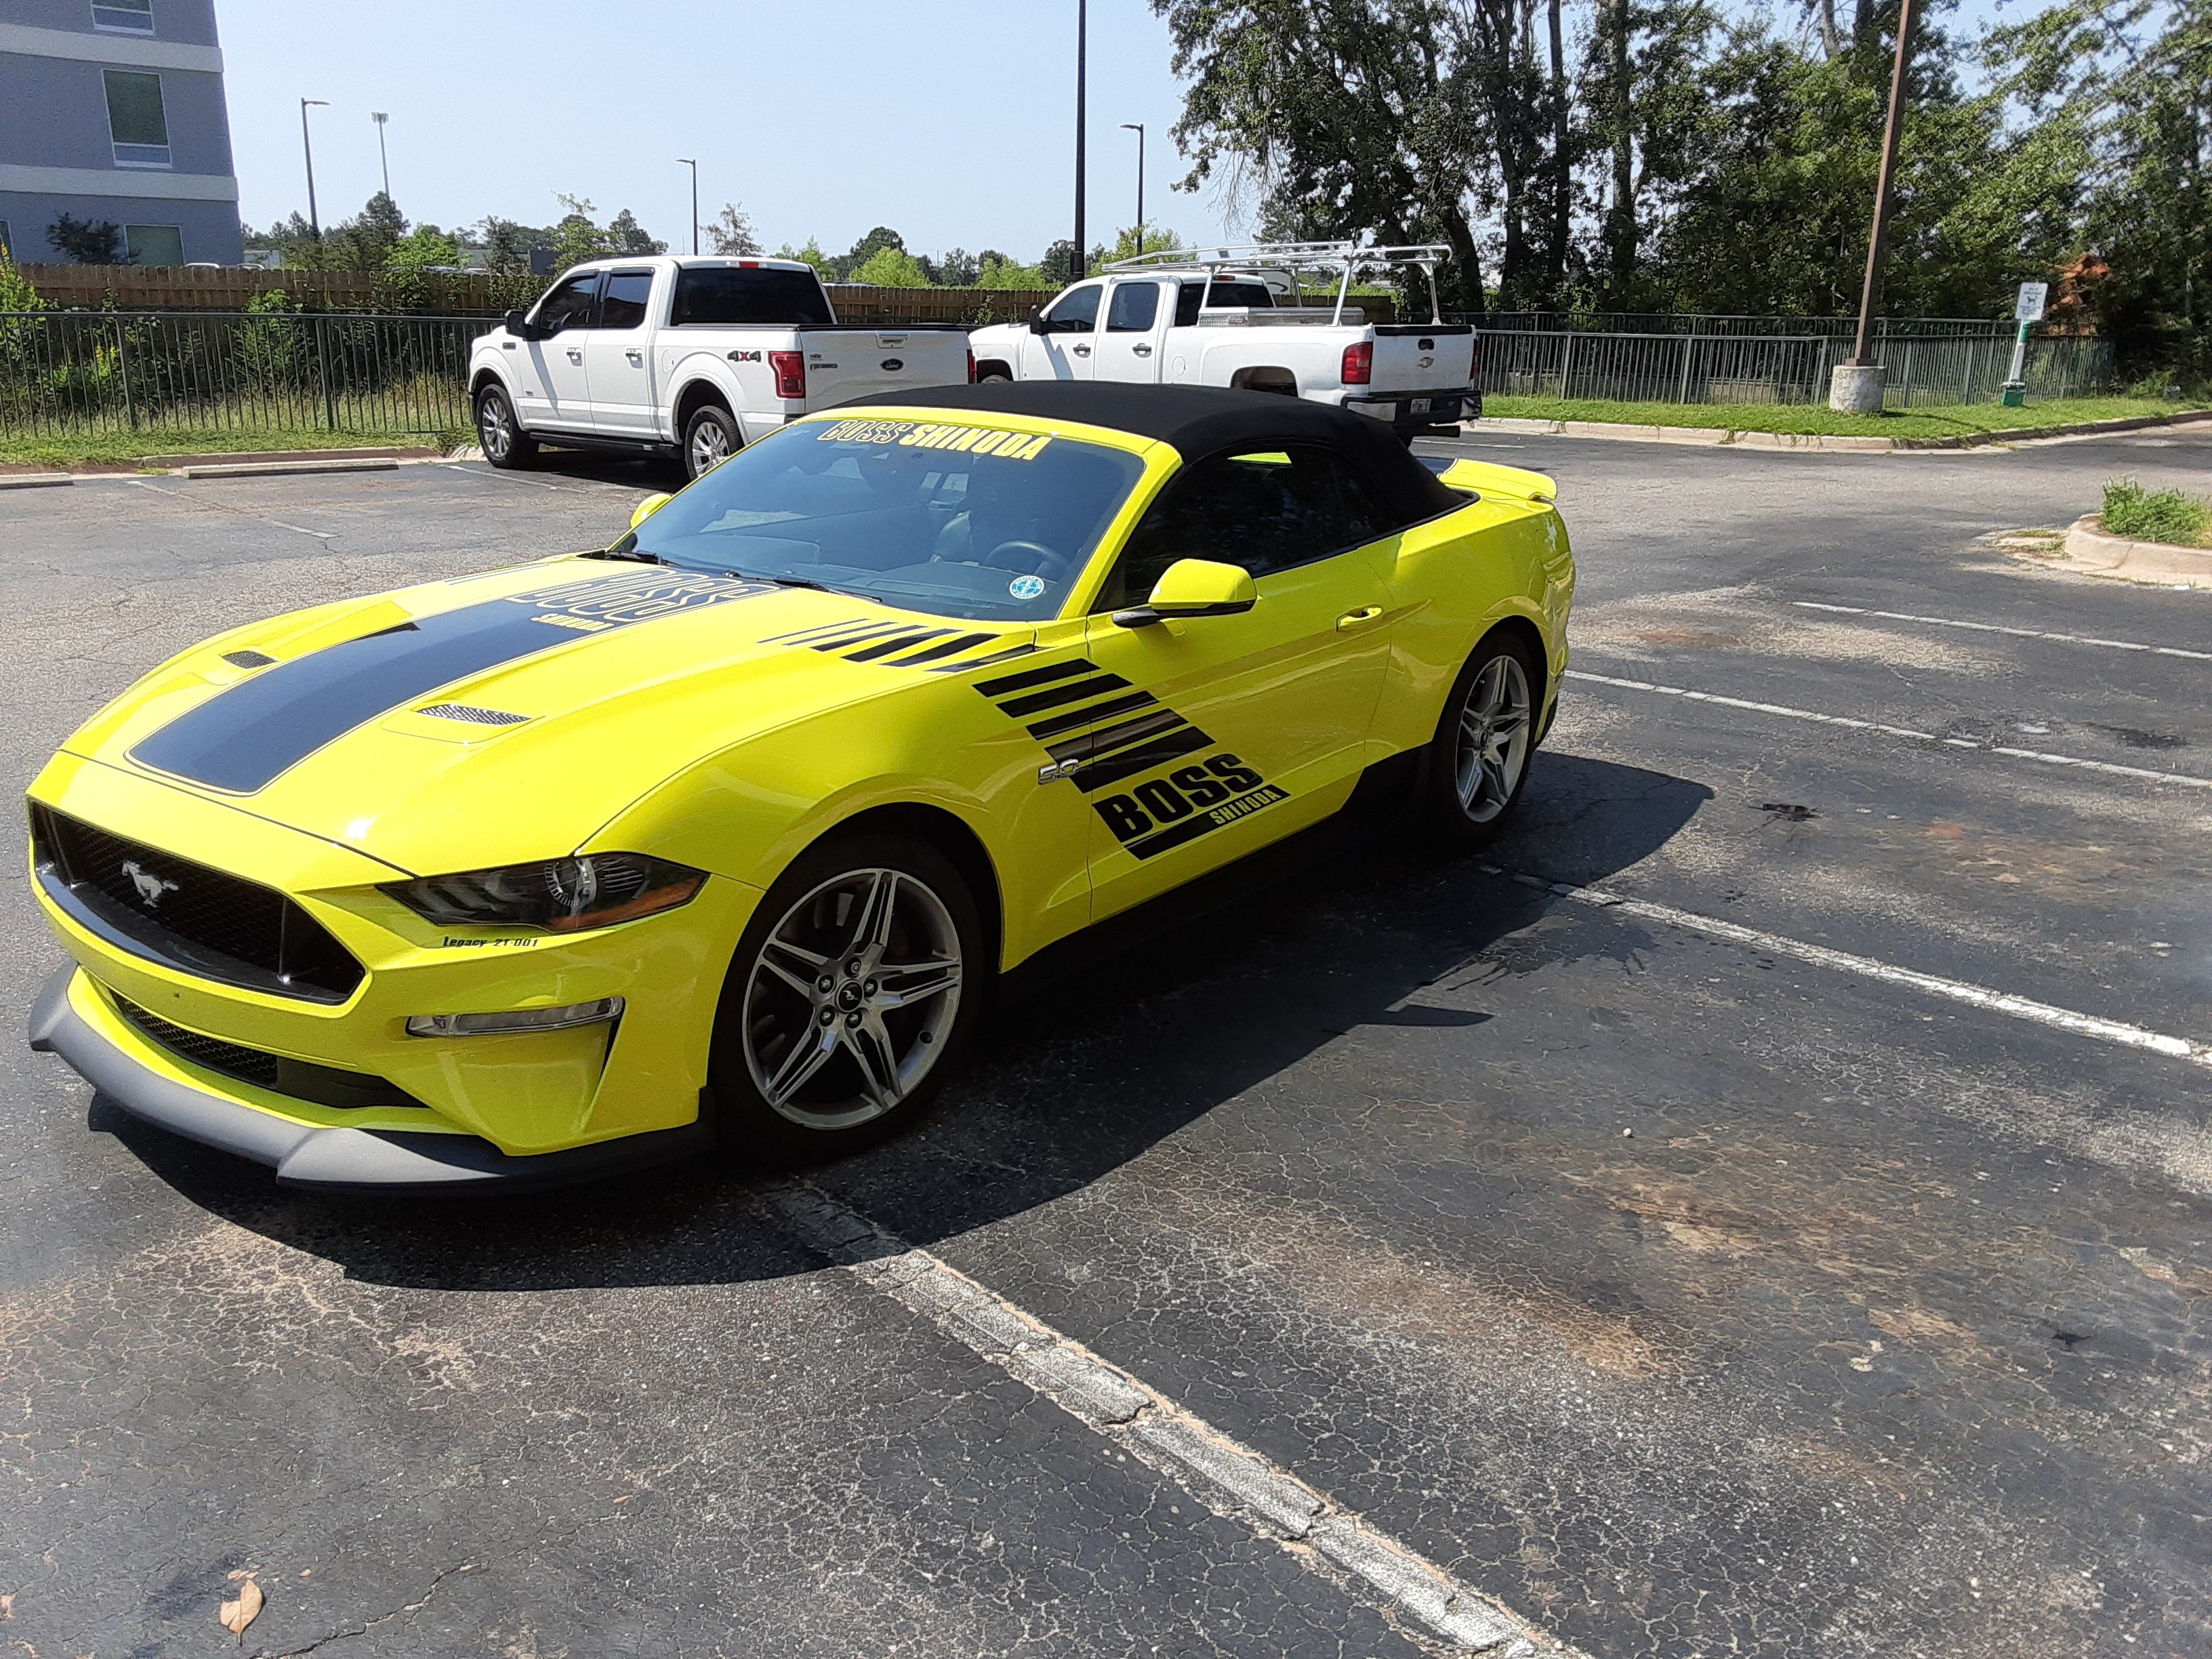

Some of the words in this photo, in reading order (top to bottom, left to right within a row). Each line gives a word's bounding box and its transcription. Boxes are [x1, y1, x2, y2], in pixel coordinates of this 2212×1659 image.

[817, 419, 914, 444] BOSS
[899, 424, 1052, 460] SHINODA
[505, 567, 781, 622] BOSS
[1092, 754, 1263, 843] BOSS
[1209, 786, 1282, 825] SHINODA
[443, 936, 488, 947] Legacy
